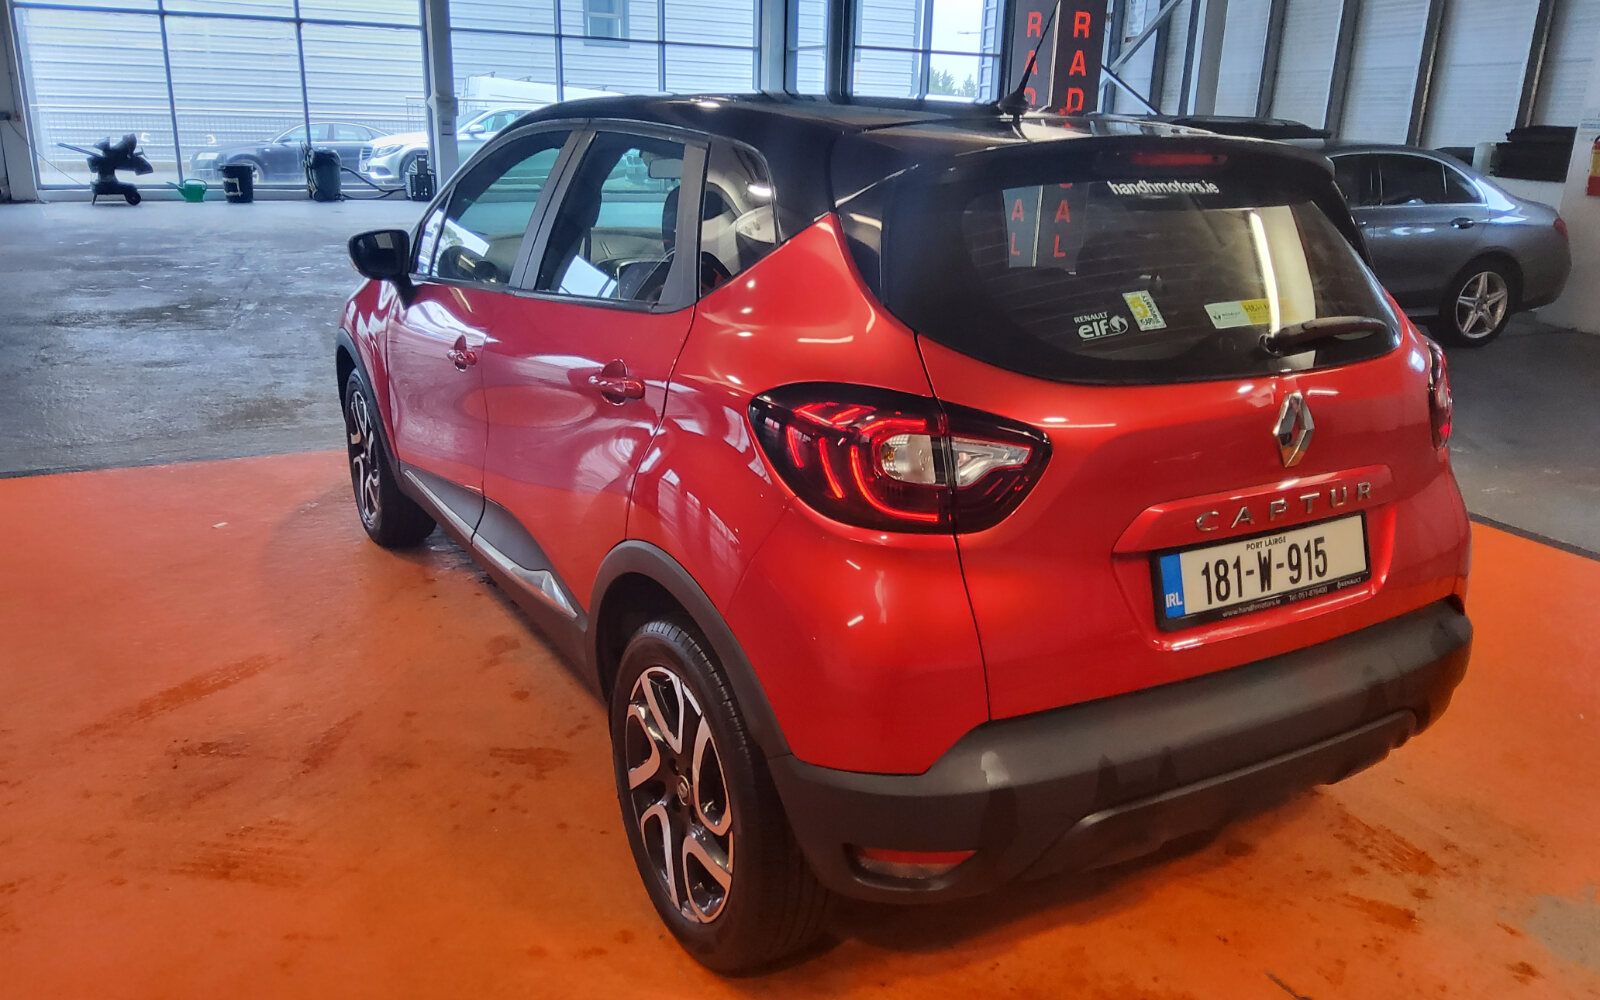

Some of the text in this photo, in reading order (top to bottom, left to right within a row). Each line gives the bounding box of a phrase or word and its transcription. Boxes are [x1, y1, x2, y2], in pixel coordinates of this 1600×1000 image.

[1107, 179, 1220, 196] handhmotors.ie
[1074, 311, 1108, 324] RENAULT
[1078, 319, 1109, 339] elf
[1196, 482, 1372, 532] CAPTUR
[1246, 536, 1287, 551] PORT LÁIRGE
[1201, 536, 1328, 605] 181-W-915
[1165, 593, 1183, 609] IRL
